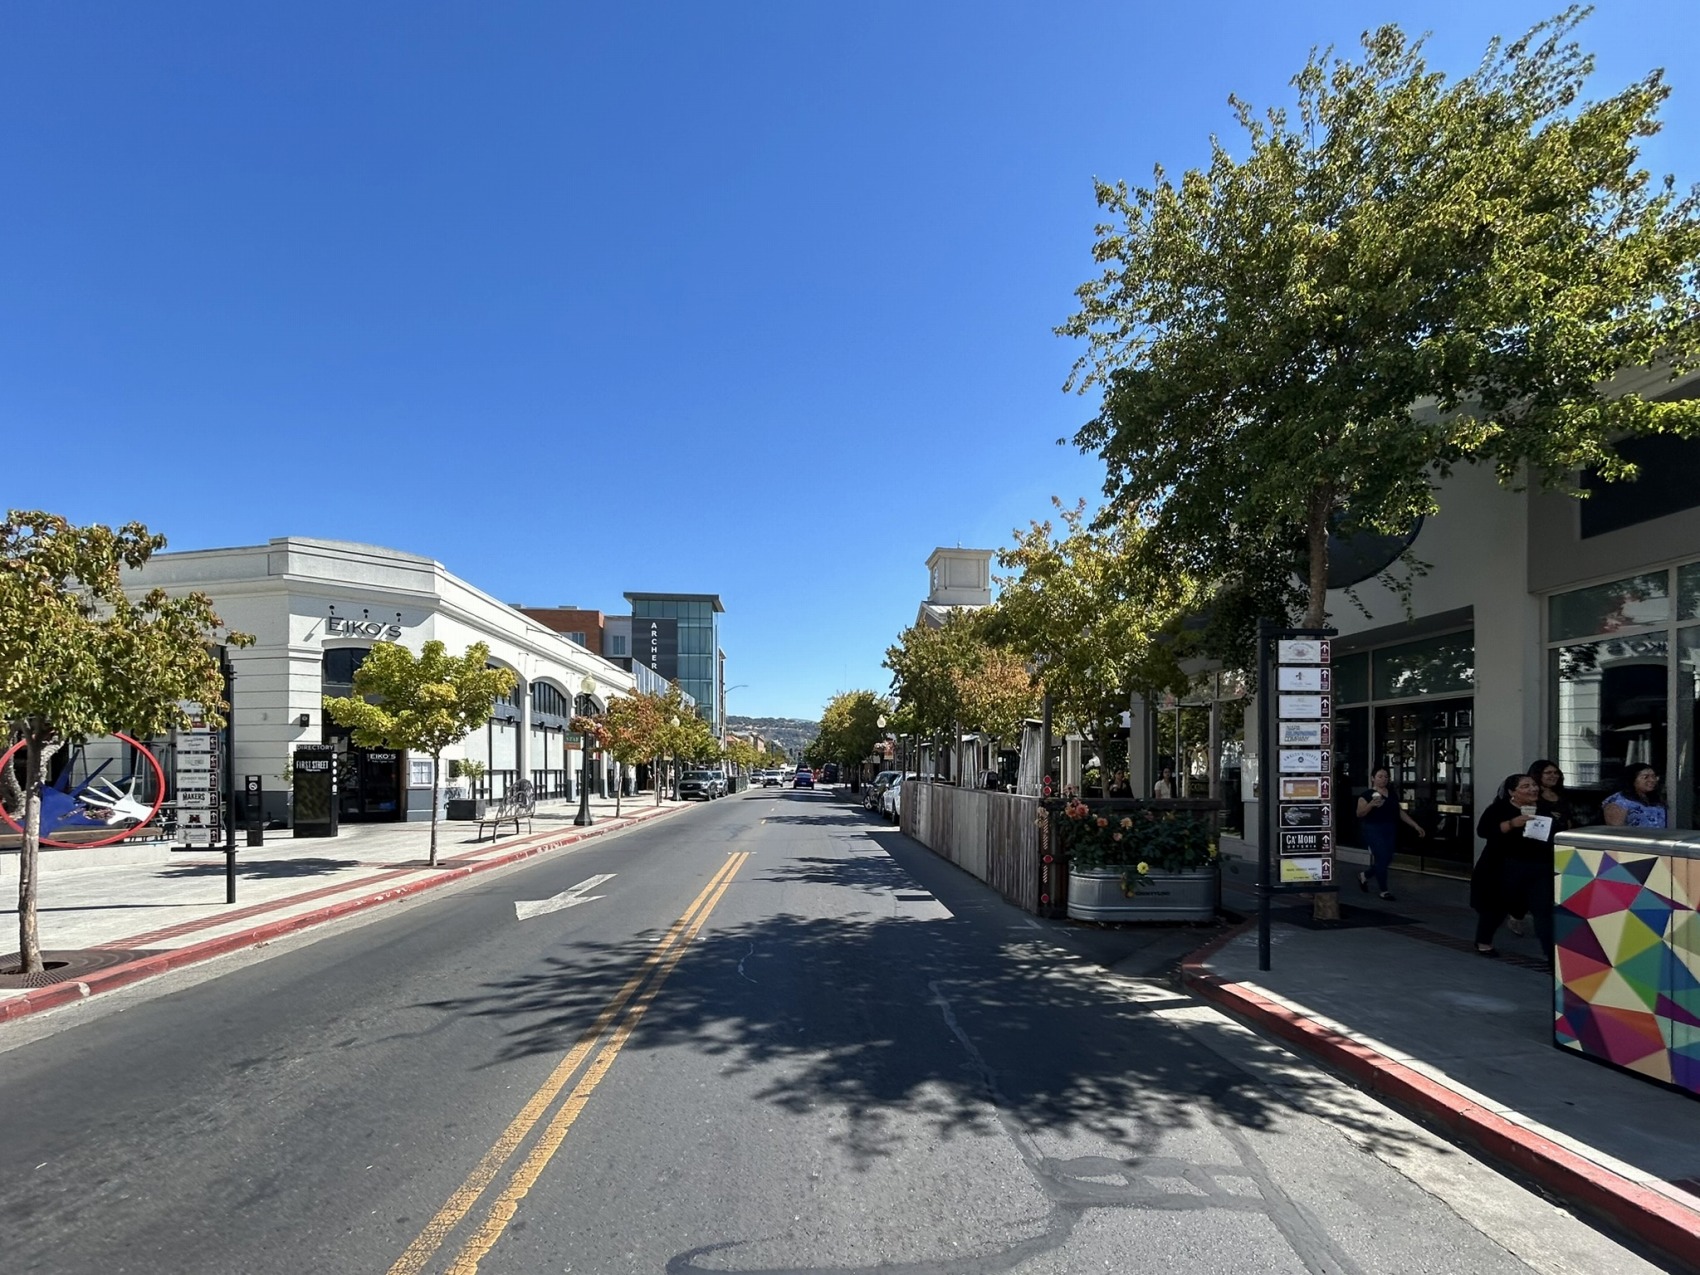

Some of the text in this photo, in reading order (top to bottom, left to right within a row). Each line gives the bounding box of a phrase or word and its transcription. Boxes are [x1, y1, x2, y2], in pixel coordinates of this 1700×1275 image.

[328, 616, 402, 638] EIKO'S
[296, 760, 329, 769] FIRST STREET
[182, 793, 206, 801] MAKERS
